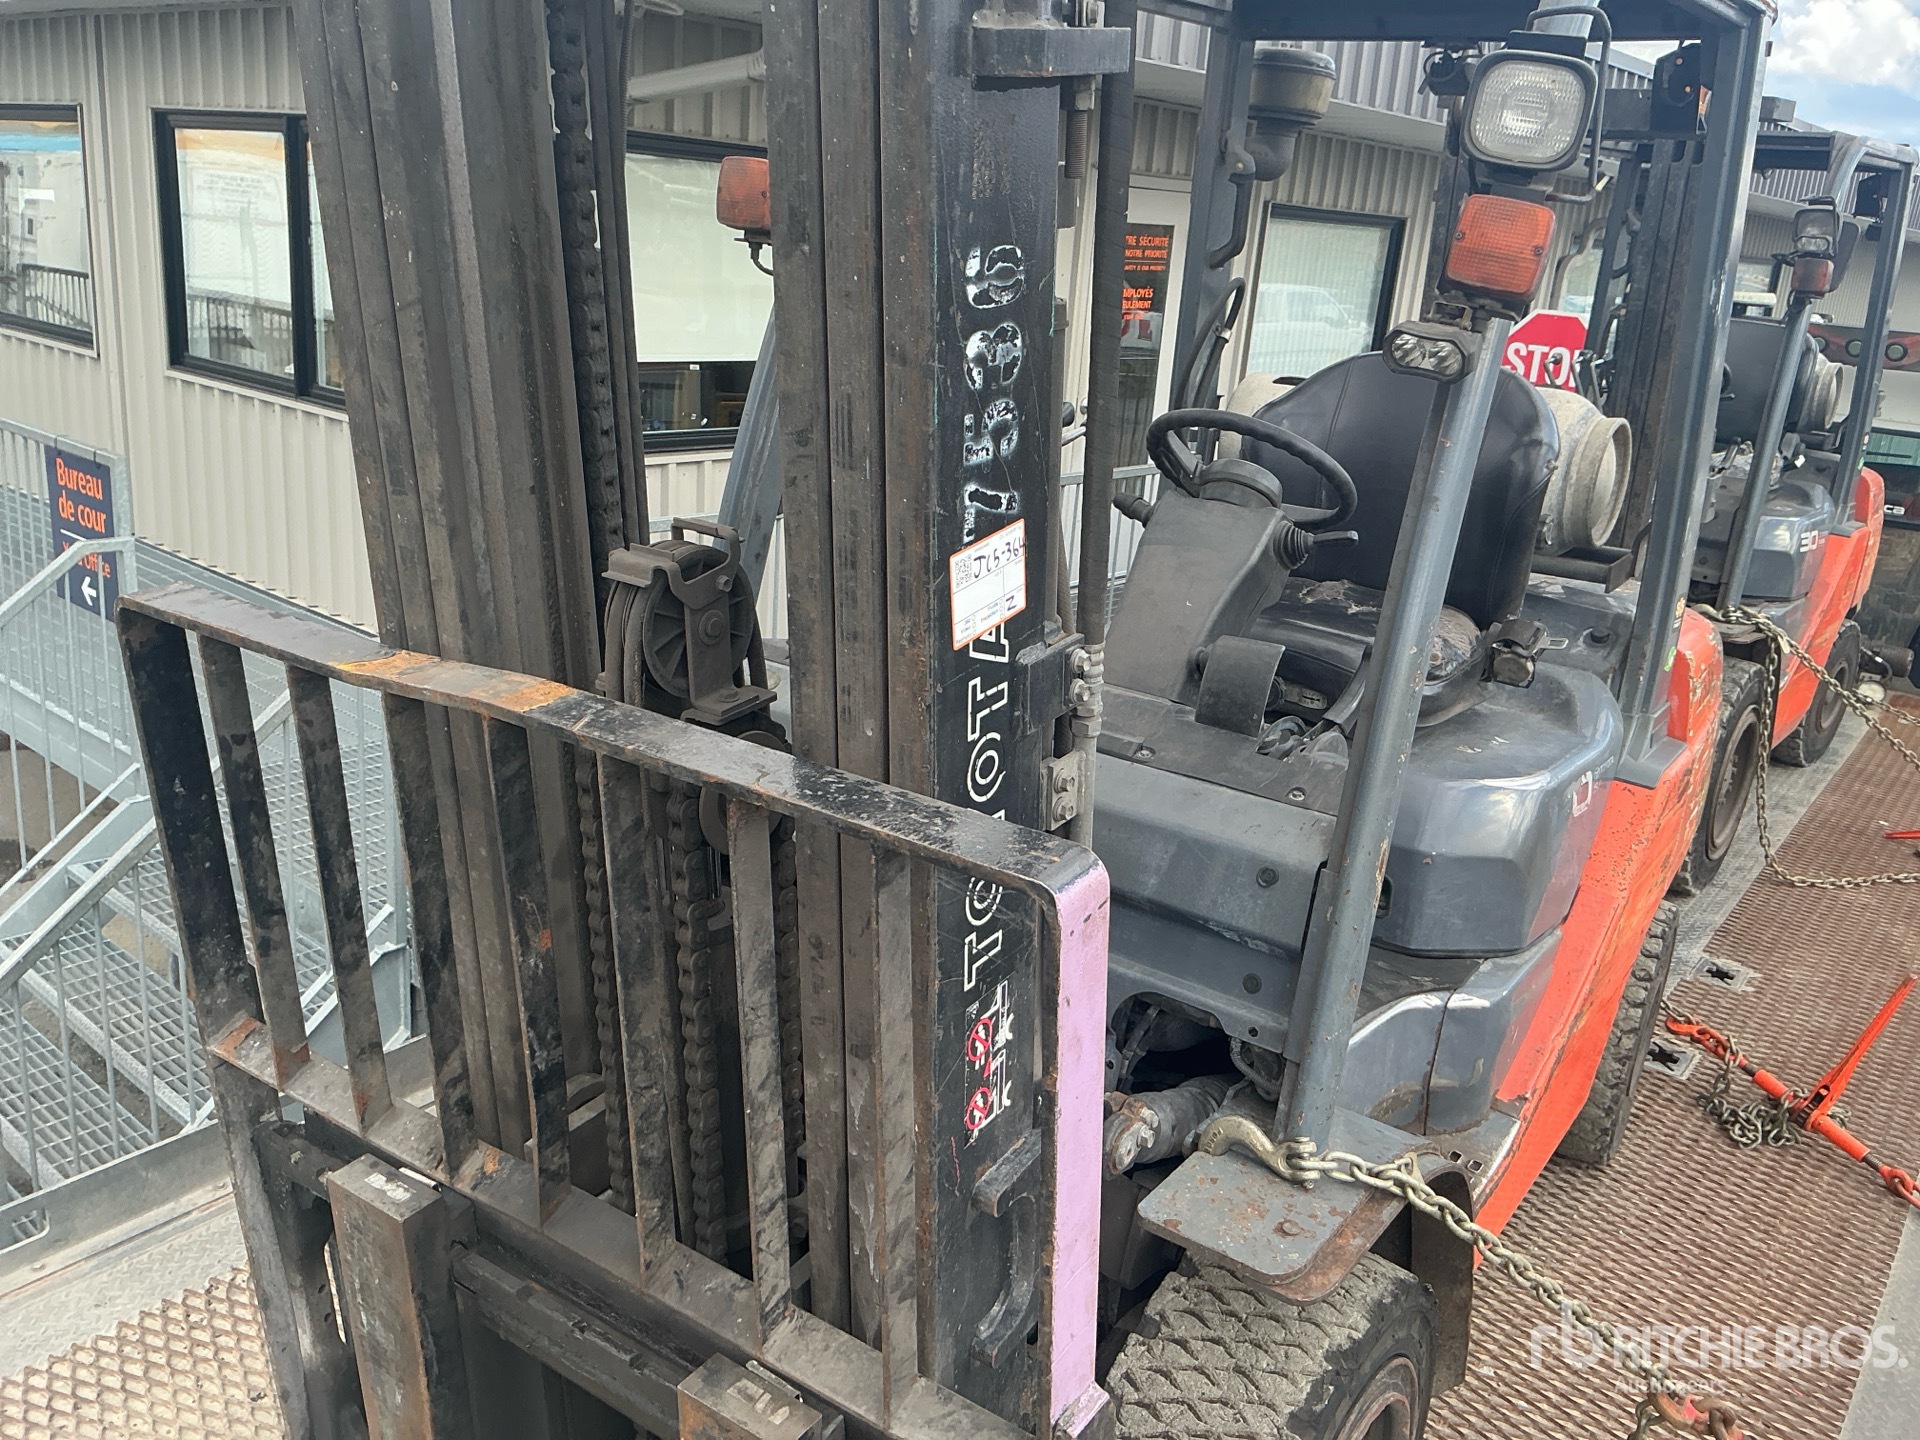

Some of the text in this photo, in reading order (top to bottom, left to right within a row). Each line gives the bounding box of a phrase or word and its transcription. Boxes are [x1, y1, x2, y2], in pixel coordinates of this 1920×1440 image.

[55, 457, 103, 500] Bureau
[58, 490, 107, 534] de cour
[1799, 530, 1819, 553] 30
[83, 552, 111, 578] Offe
[964, 622, 1010, 991] TOOT
